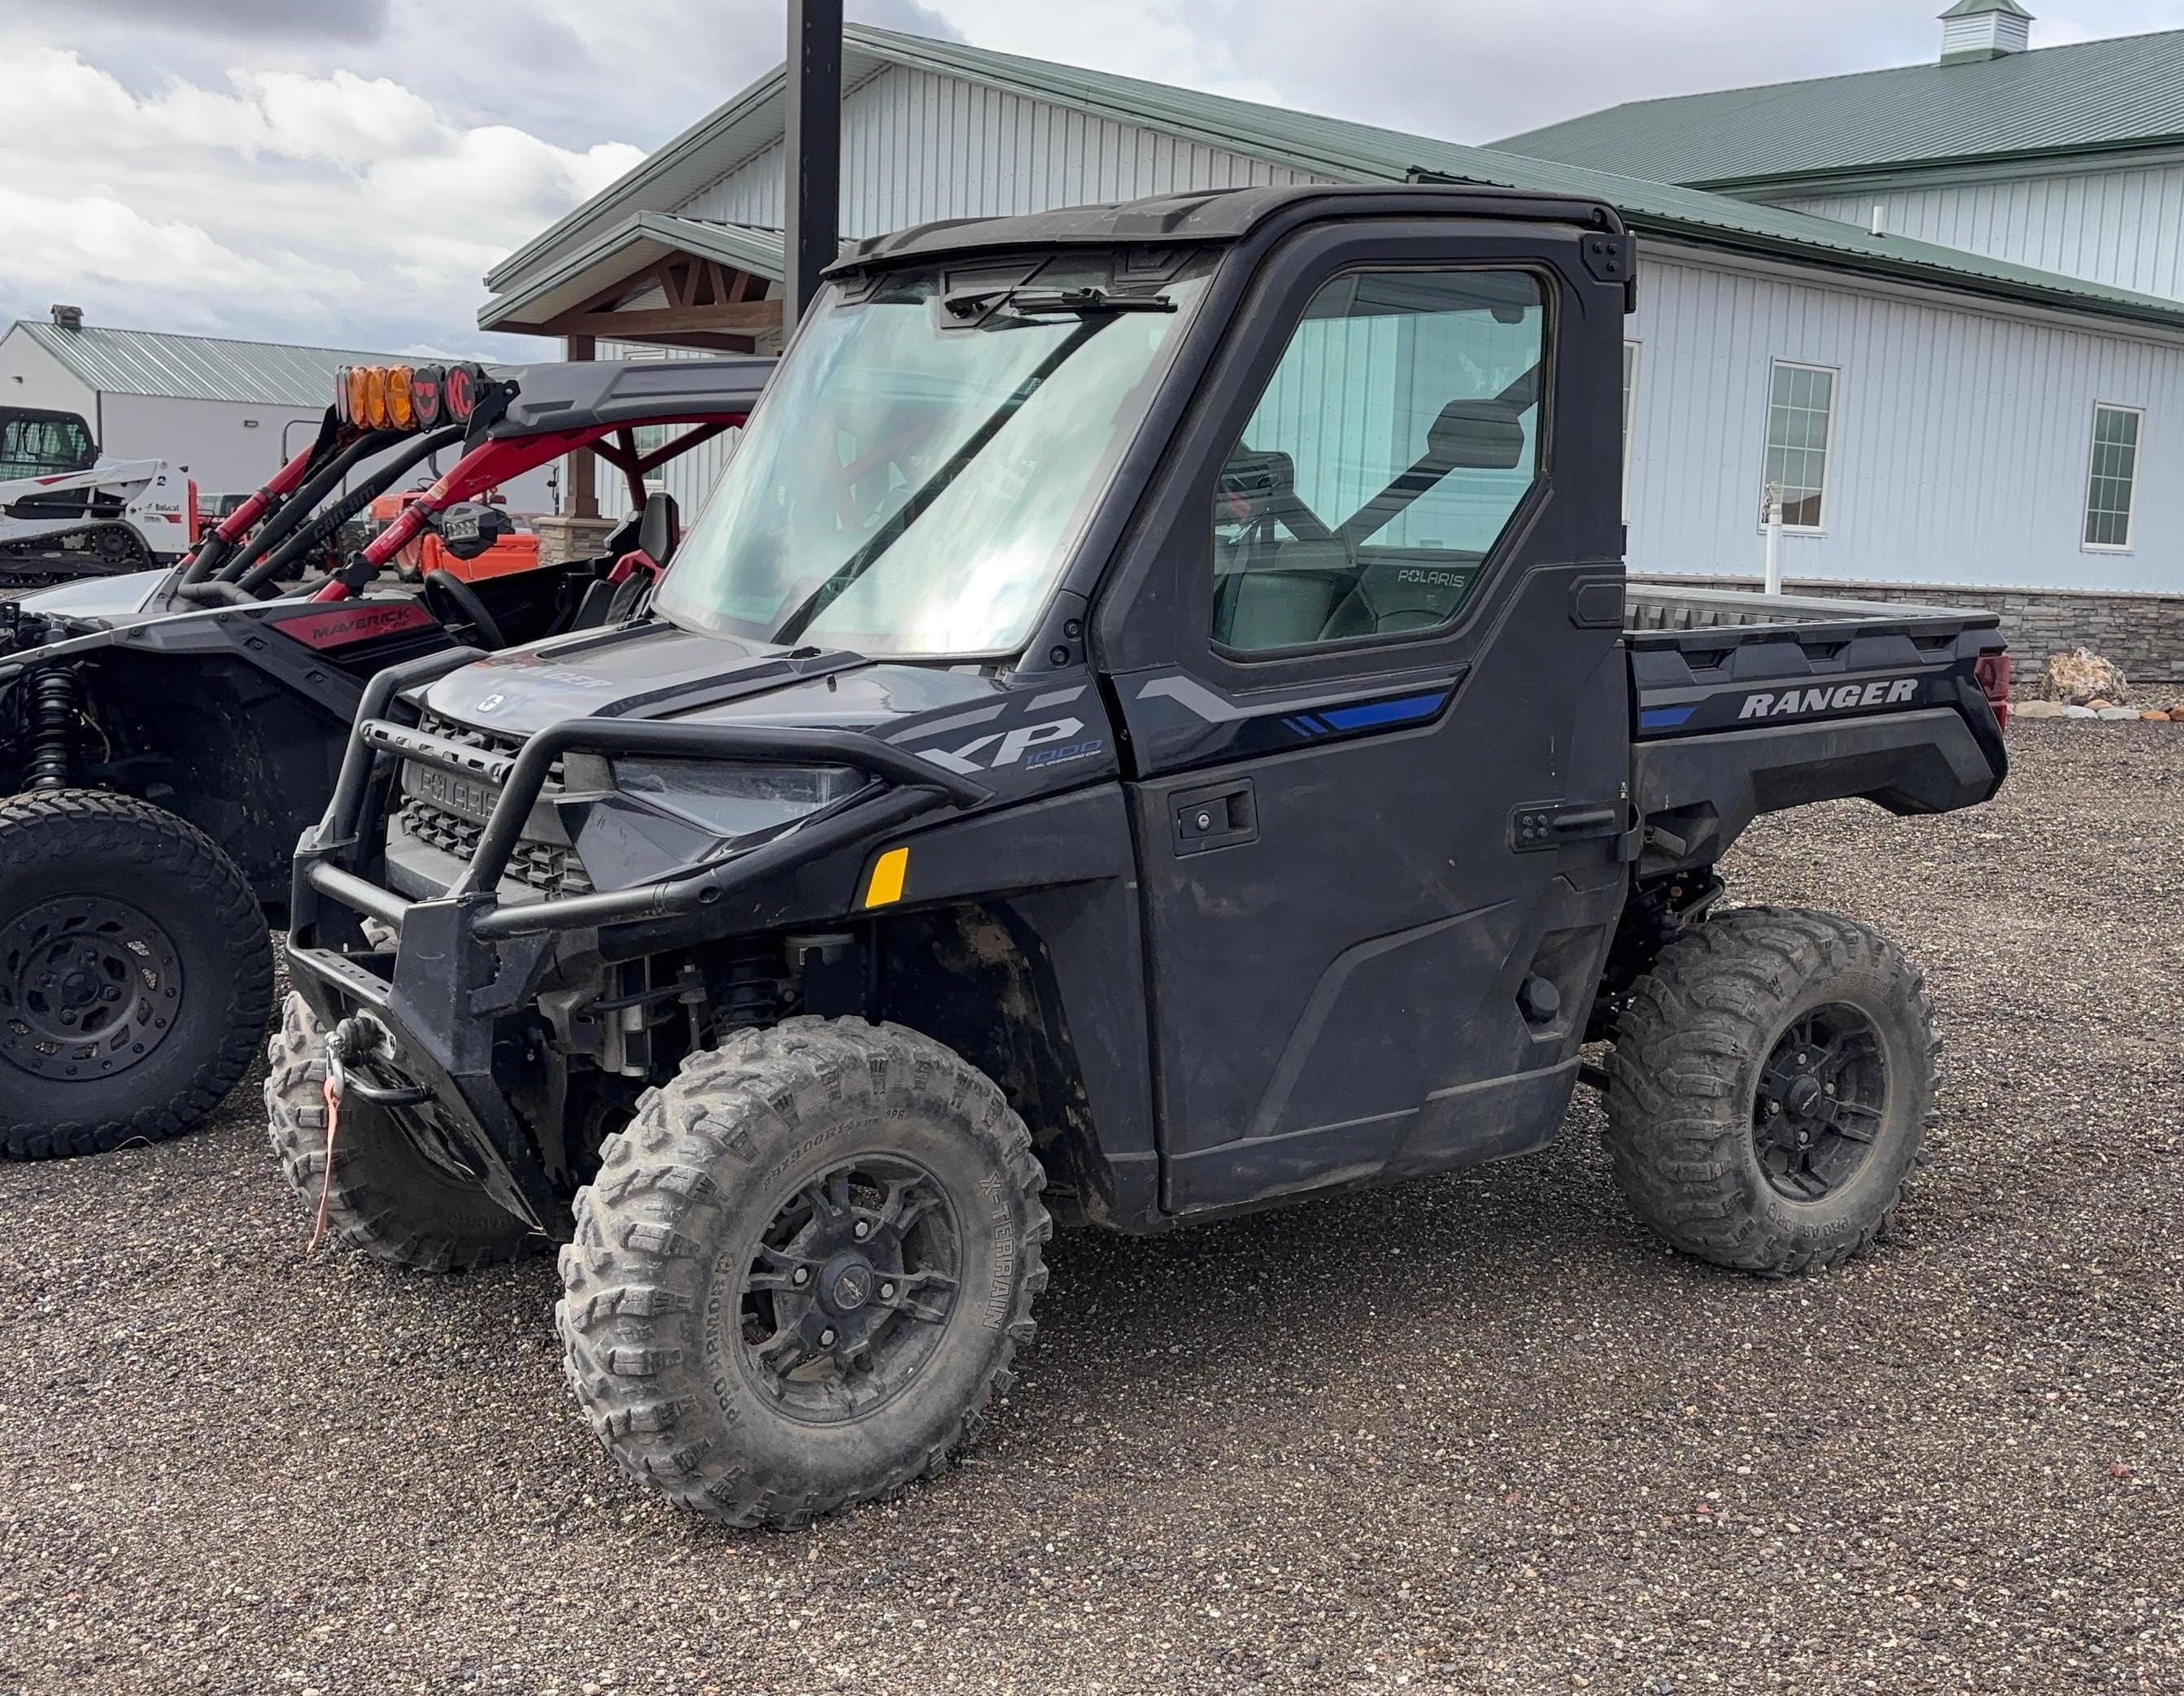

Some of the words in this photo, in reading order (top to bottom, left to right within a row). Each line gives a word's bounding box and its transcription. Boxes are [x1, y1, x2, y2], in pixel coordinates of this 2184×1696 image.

[447, 369, 471, 419] KC
[155, 504, 180, 512] Bobcat
[1397, 569, 1466, 587] POLARIS
[312, 608, 411, 639] MAVERICK
[1738, 678, 1918, 719] RANGER
[914, 717, 1085, 774] XP
[1026, 739, 1102, 765] 1000
[421, 768, 498, 819] POLARIS
[979, 1171, 1014, 1331] X-TERRAIN
[713, 1376, 739, 1425] PRO
